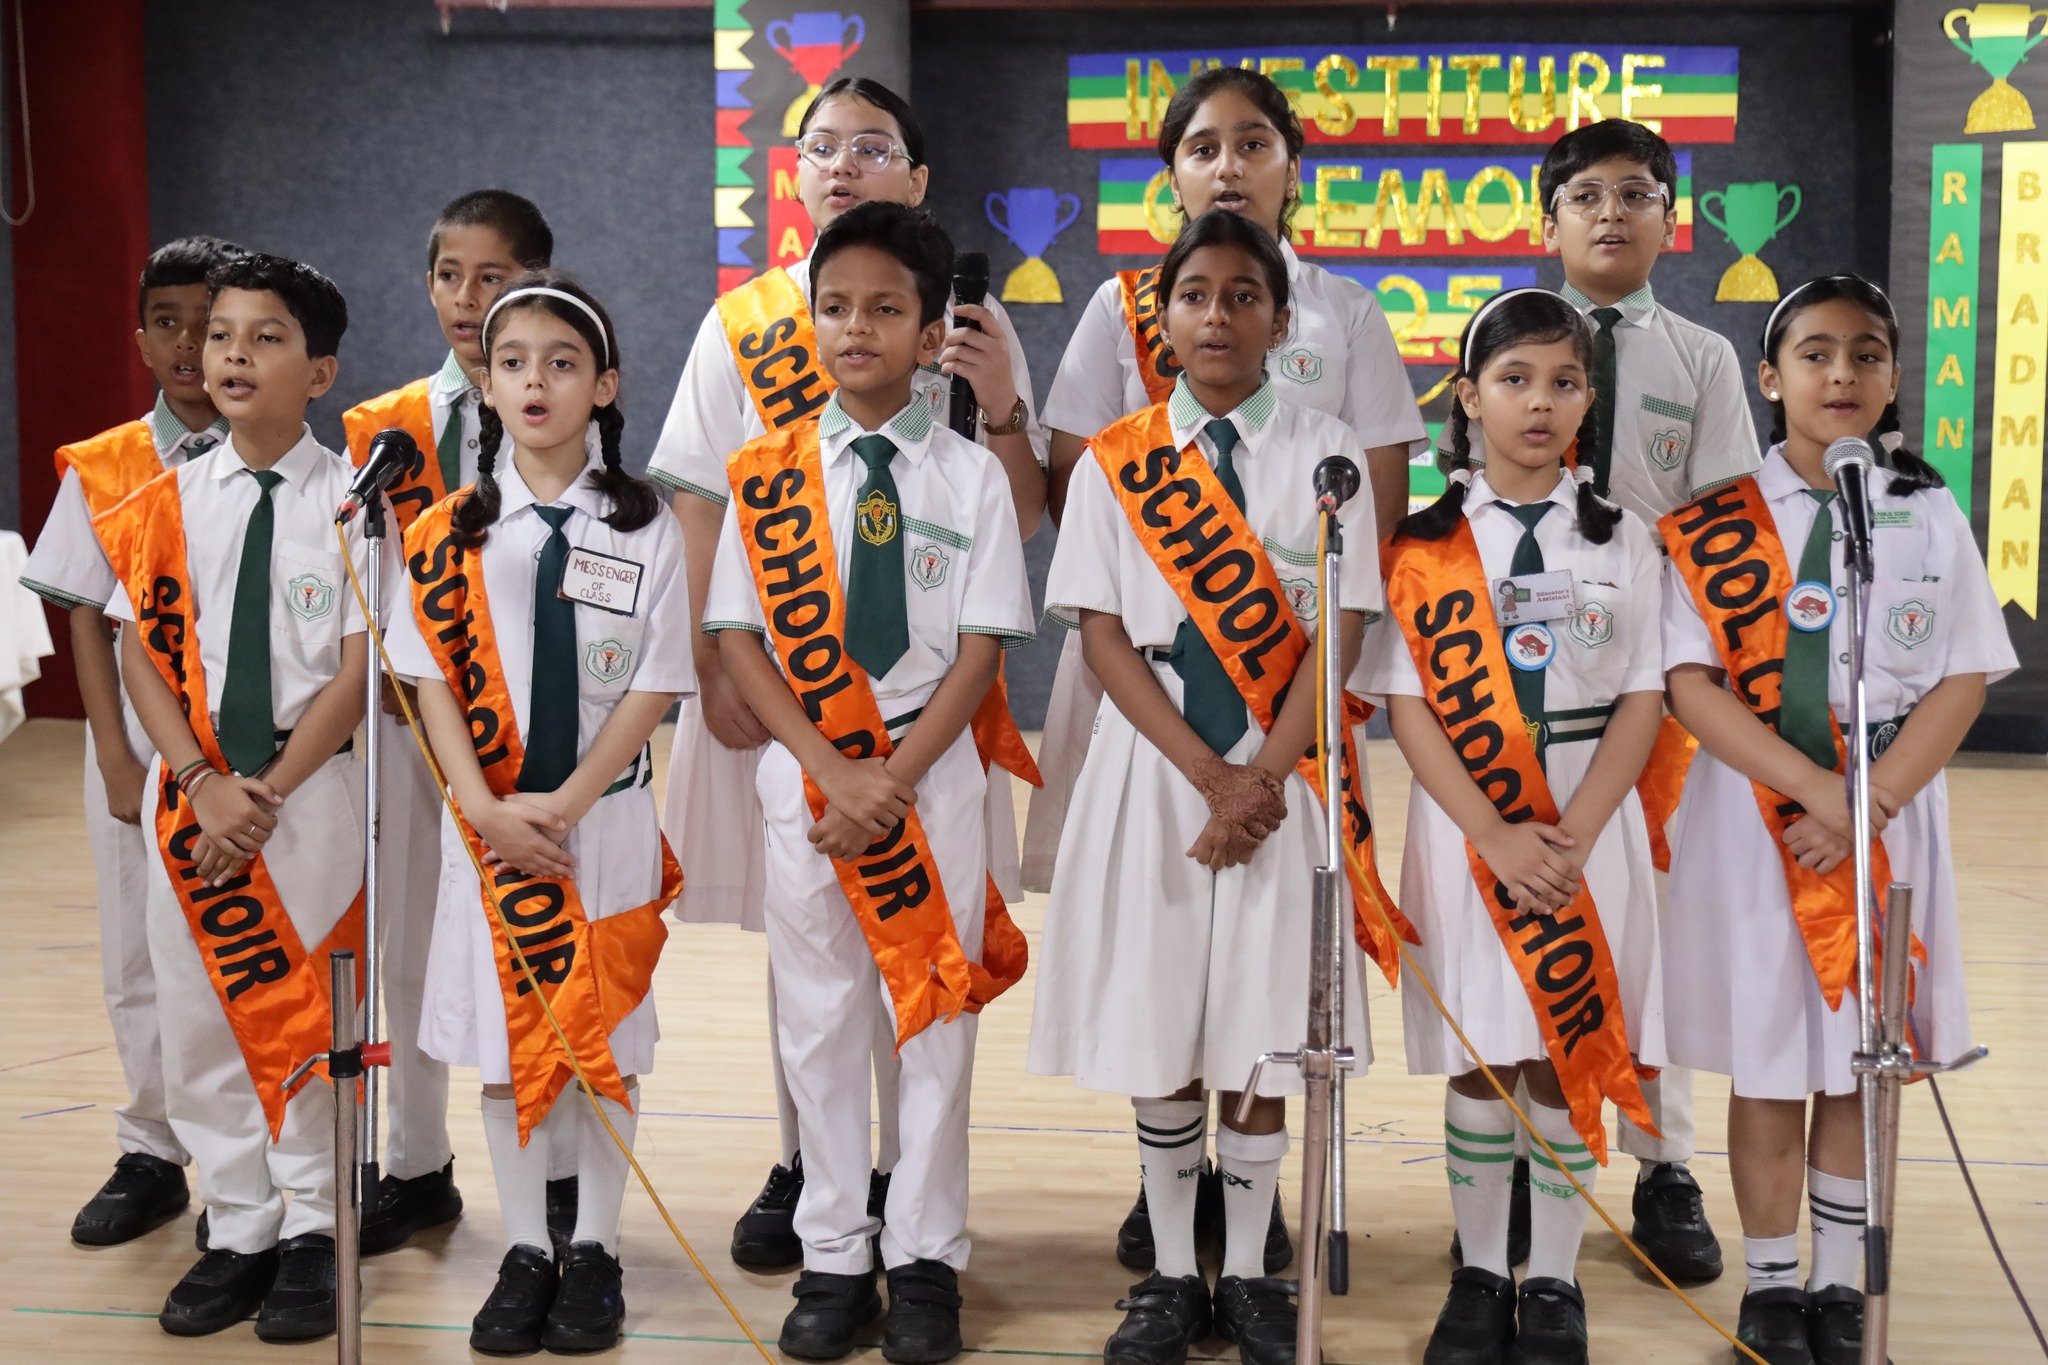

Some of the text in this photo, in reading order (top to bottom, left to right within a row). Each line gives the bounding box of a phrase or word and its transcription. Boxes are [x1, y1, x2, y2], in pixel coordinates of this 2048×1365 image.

[1126, 53, 1666, 139] INSTITURE
[1143, 165, 1543, 249] CEMO
[1932, 171, 1970, 449] RAMAN
[739, 317, 831, 428] SCH
[1999, 171, 2042, 570] BRADMAN
[573, 558, 637, 585] MESSENGER
[580, 588, 612, 603] CLASS
[591, 581, 605, 592] OF
[742, 468, 853, 723] SCHOOL
[1119, 445, 1291, 681] SCHOOL
[1671, 485, 1780, 652] HOOL
[494, 868, 576, 997] OIR
